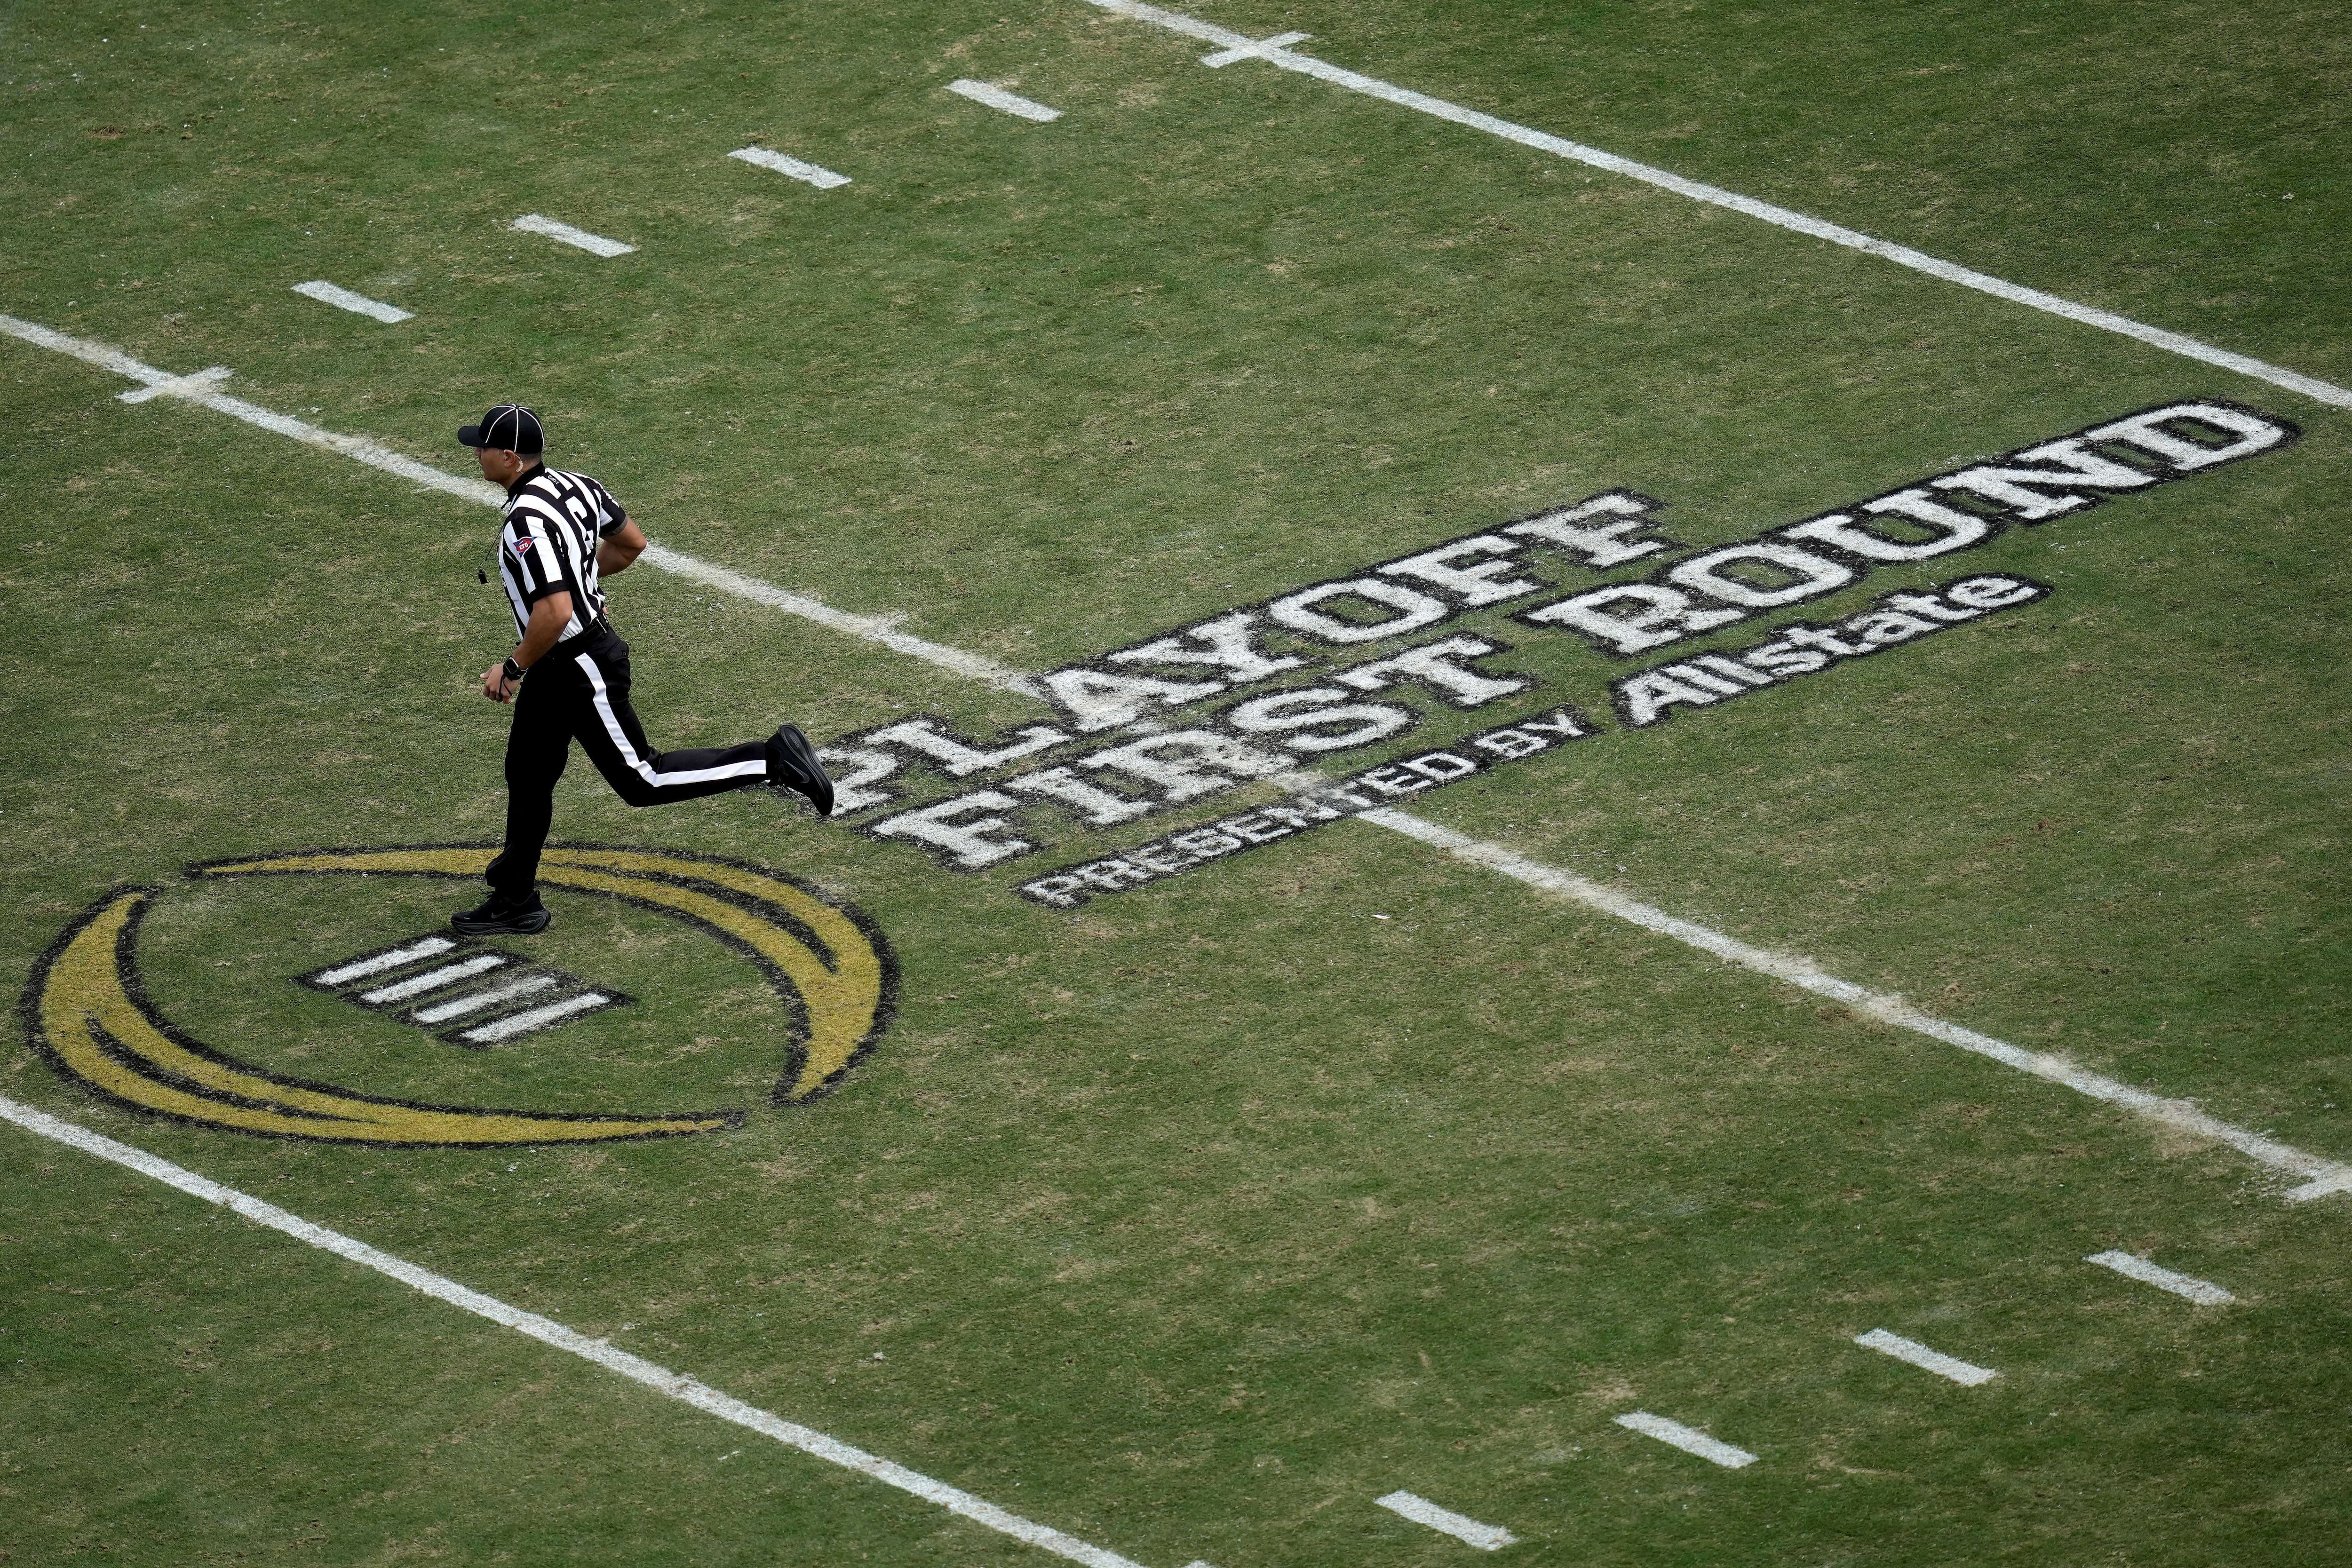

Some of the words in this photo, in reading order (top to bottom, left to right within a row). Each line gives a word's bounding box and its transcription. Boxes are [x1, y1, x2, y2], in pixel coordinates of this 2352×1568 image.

[765, 495, 1664, 816] PLAYOFF
[873, 636, 1525, 868] FIRST
[1526, 403, 2285, 654] ROUND
[1023, 752, 1477, 908] PRESENTED
[1473, 713, 1584, 759] BY
[1621, 575, 2038, 726] Allstate
